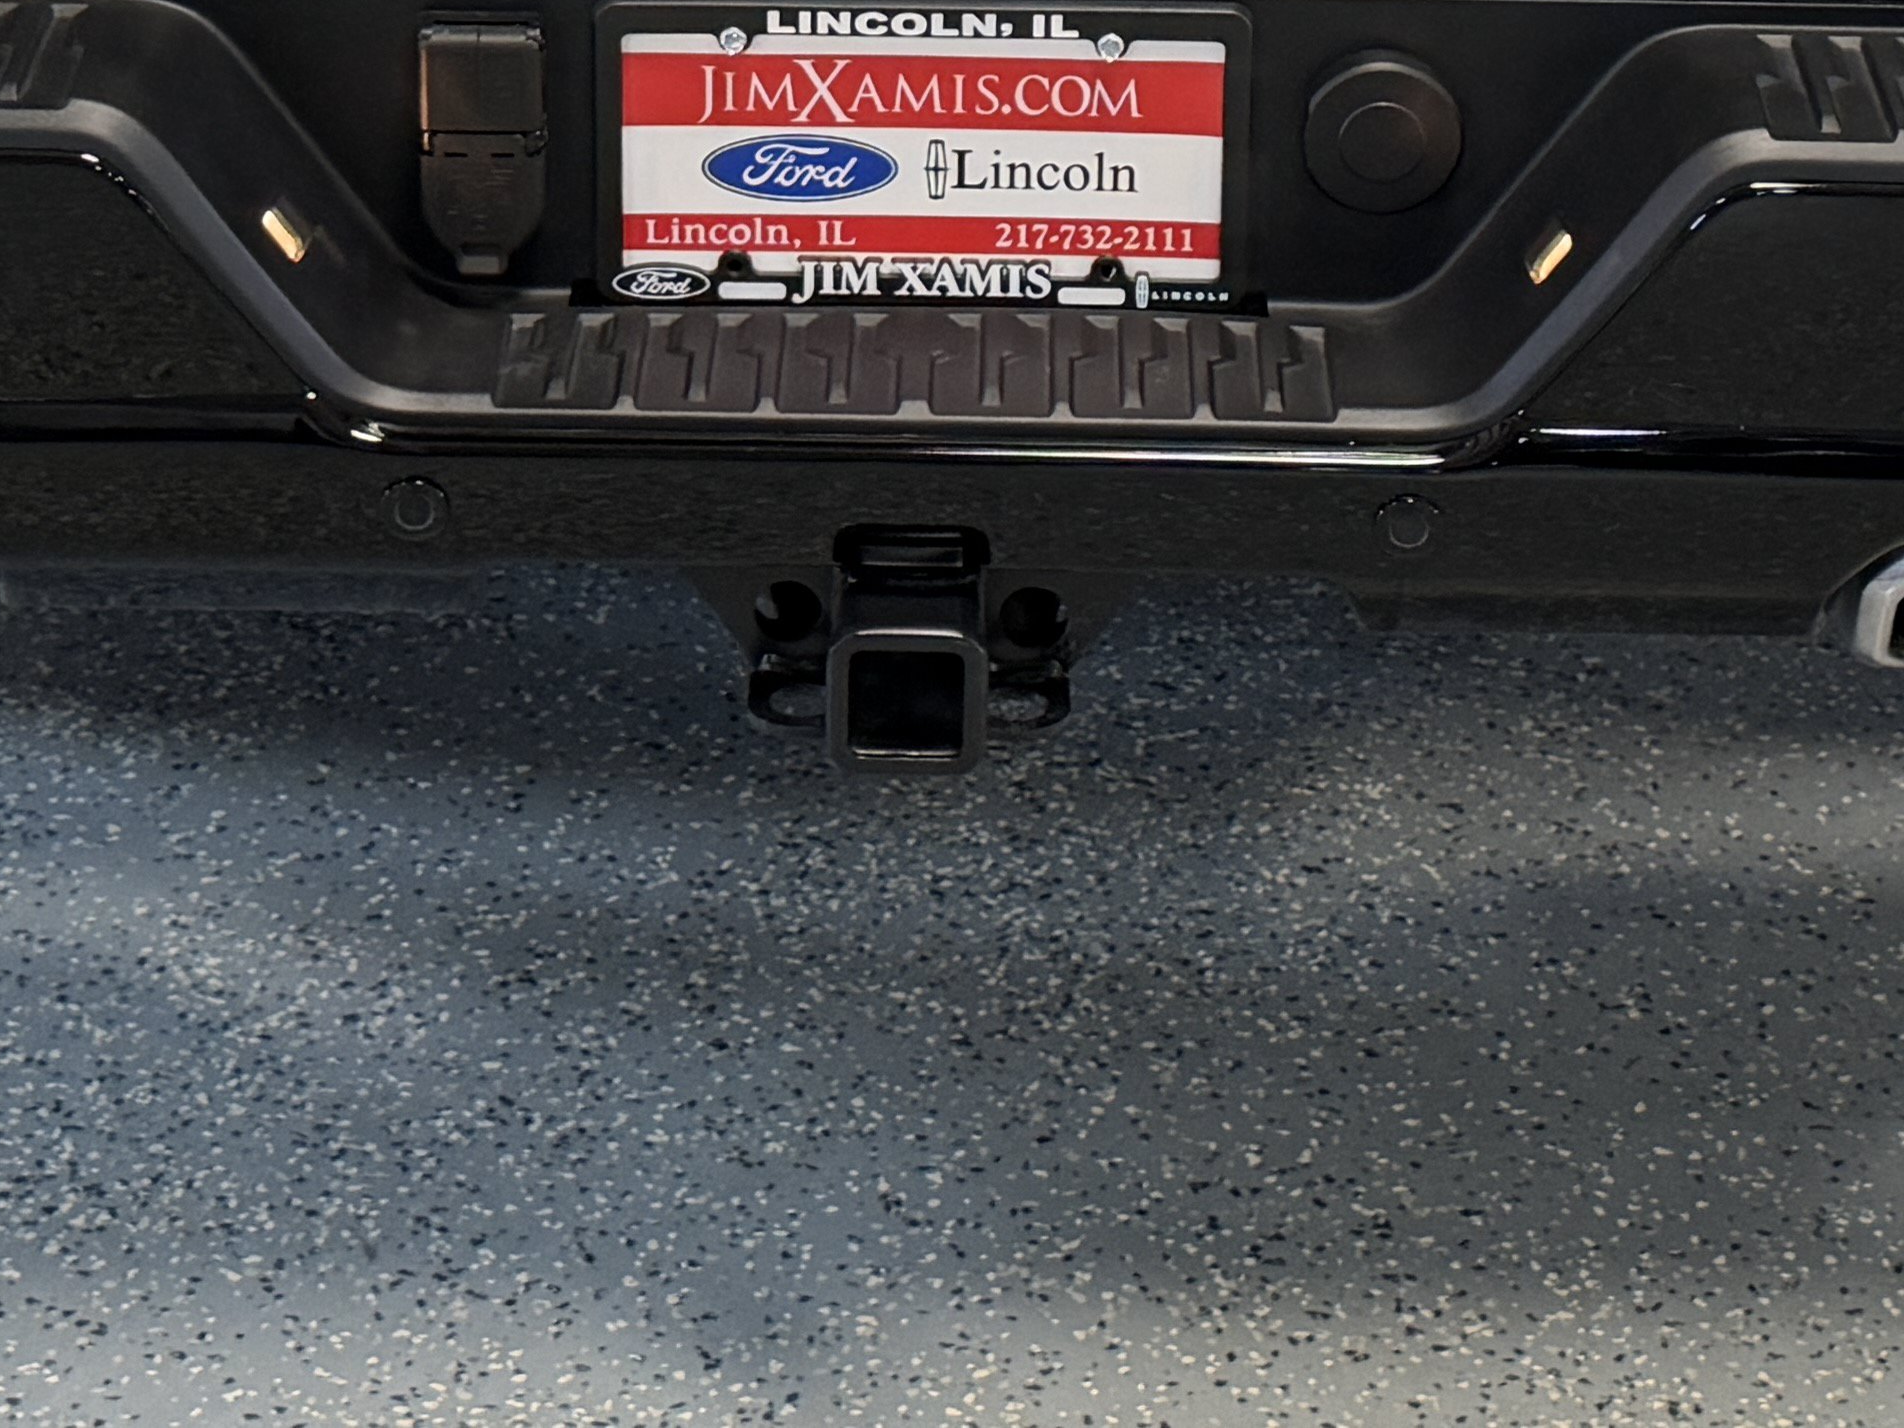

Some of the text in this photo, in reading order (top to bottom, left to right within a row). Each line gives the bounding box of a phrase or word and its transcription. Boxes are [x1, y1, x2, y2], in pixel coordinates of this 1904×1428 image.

[765, 9, 1080, 39] LINCOLN, IL
[697, 58, 1144, 125] JIMXAMIS.COM
[741, 142, 858, 190] Ford
[950, 148, 1138, 194] Lincoln
[645, 217, 858, 249] Lincoln, IL
[994, 222, 1195, 252] 217-732-2111
[630, 270, 693, 295] Ford
[790, 260, 1053, 305] JIM XAMIS
